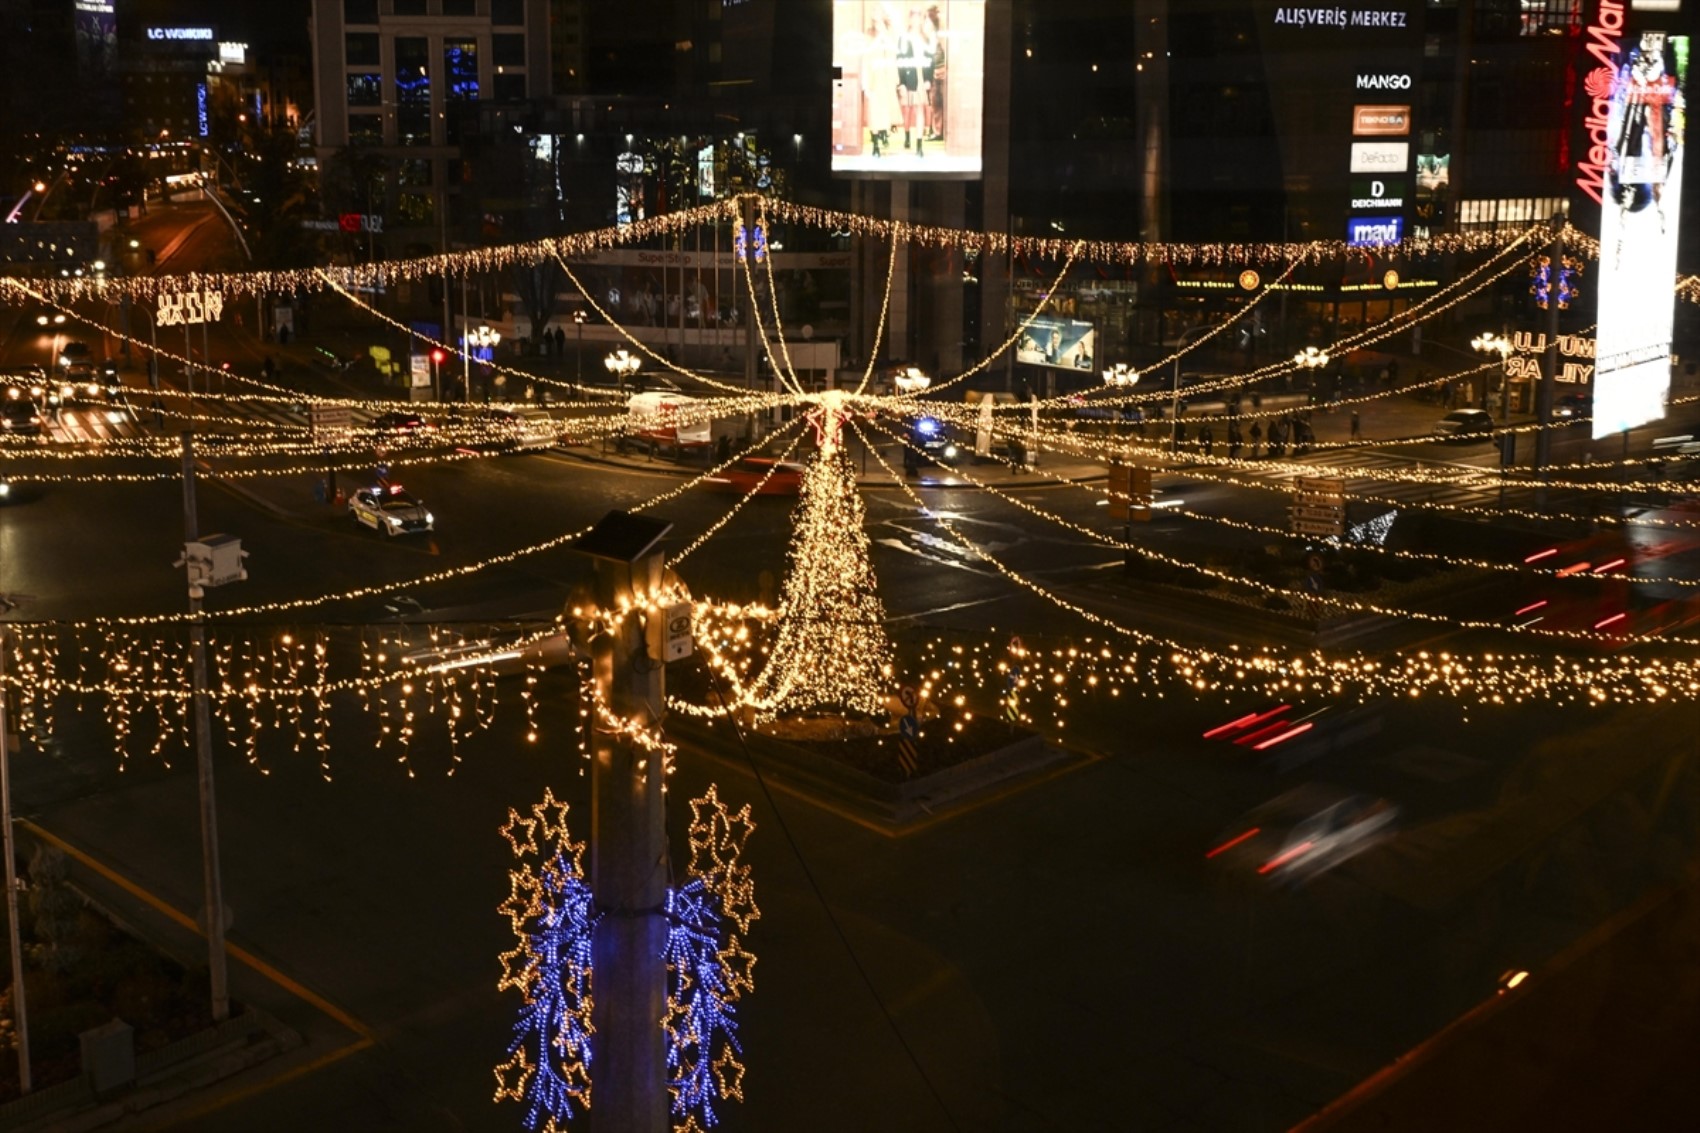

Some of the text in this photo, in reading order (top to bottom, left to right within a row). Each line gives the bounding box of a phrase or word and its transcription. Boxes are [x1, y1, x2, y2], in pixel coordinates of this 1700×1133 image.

[1275, 7, 1406, 29] ALIŞVERİŞ MERKEZ
[147, 28, 164, 39] LC
[1356, 74, 1412, 89] MANGO
[1371, 181, 1385, 198] D
[1351, 198, 1403, 208] DEICHMANN
[1354, 218, 1398, 242] mavi
